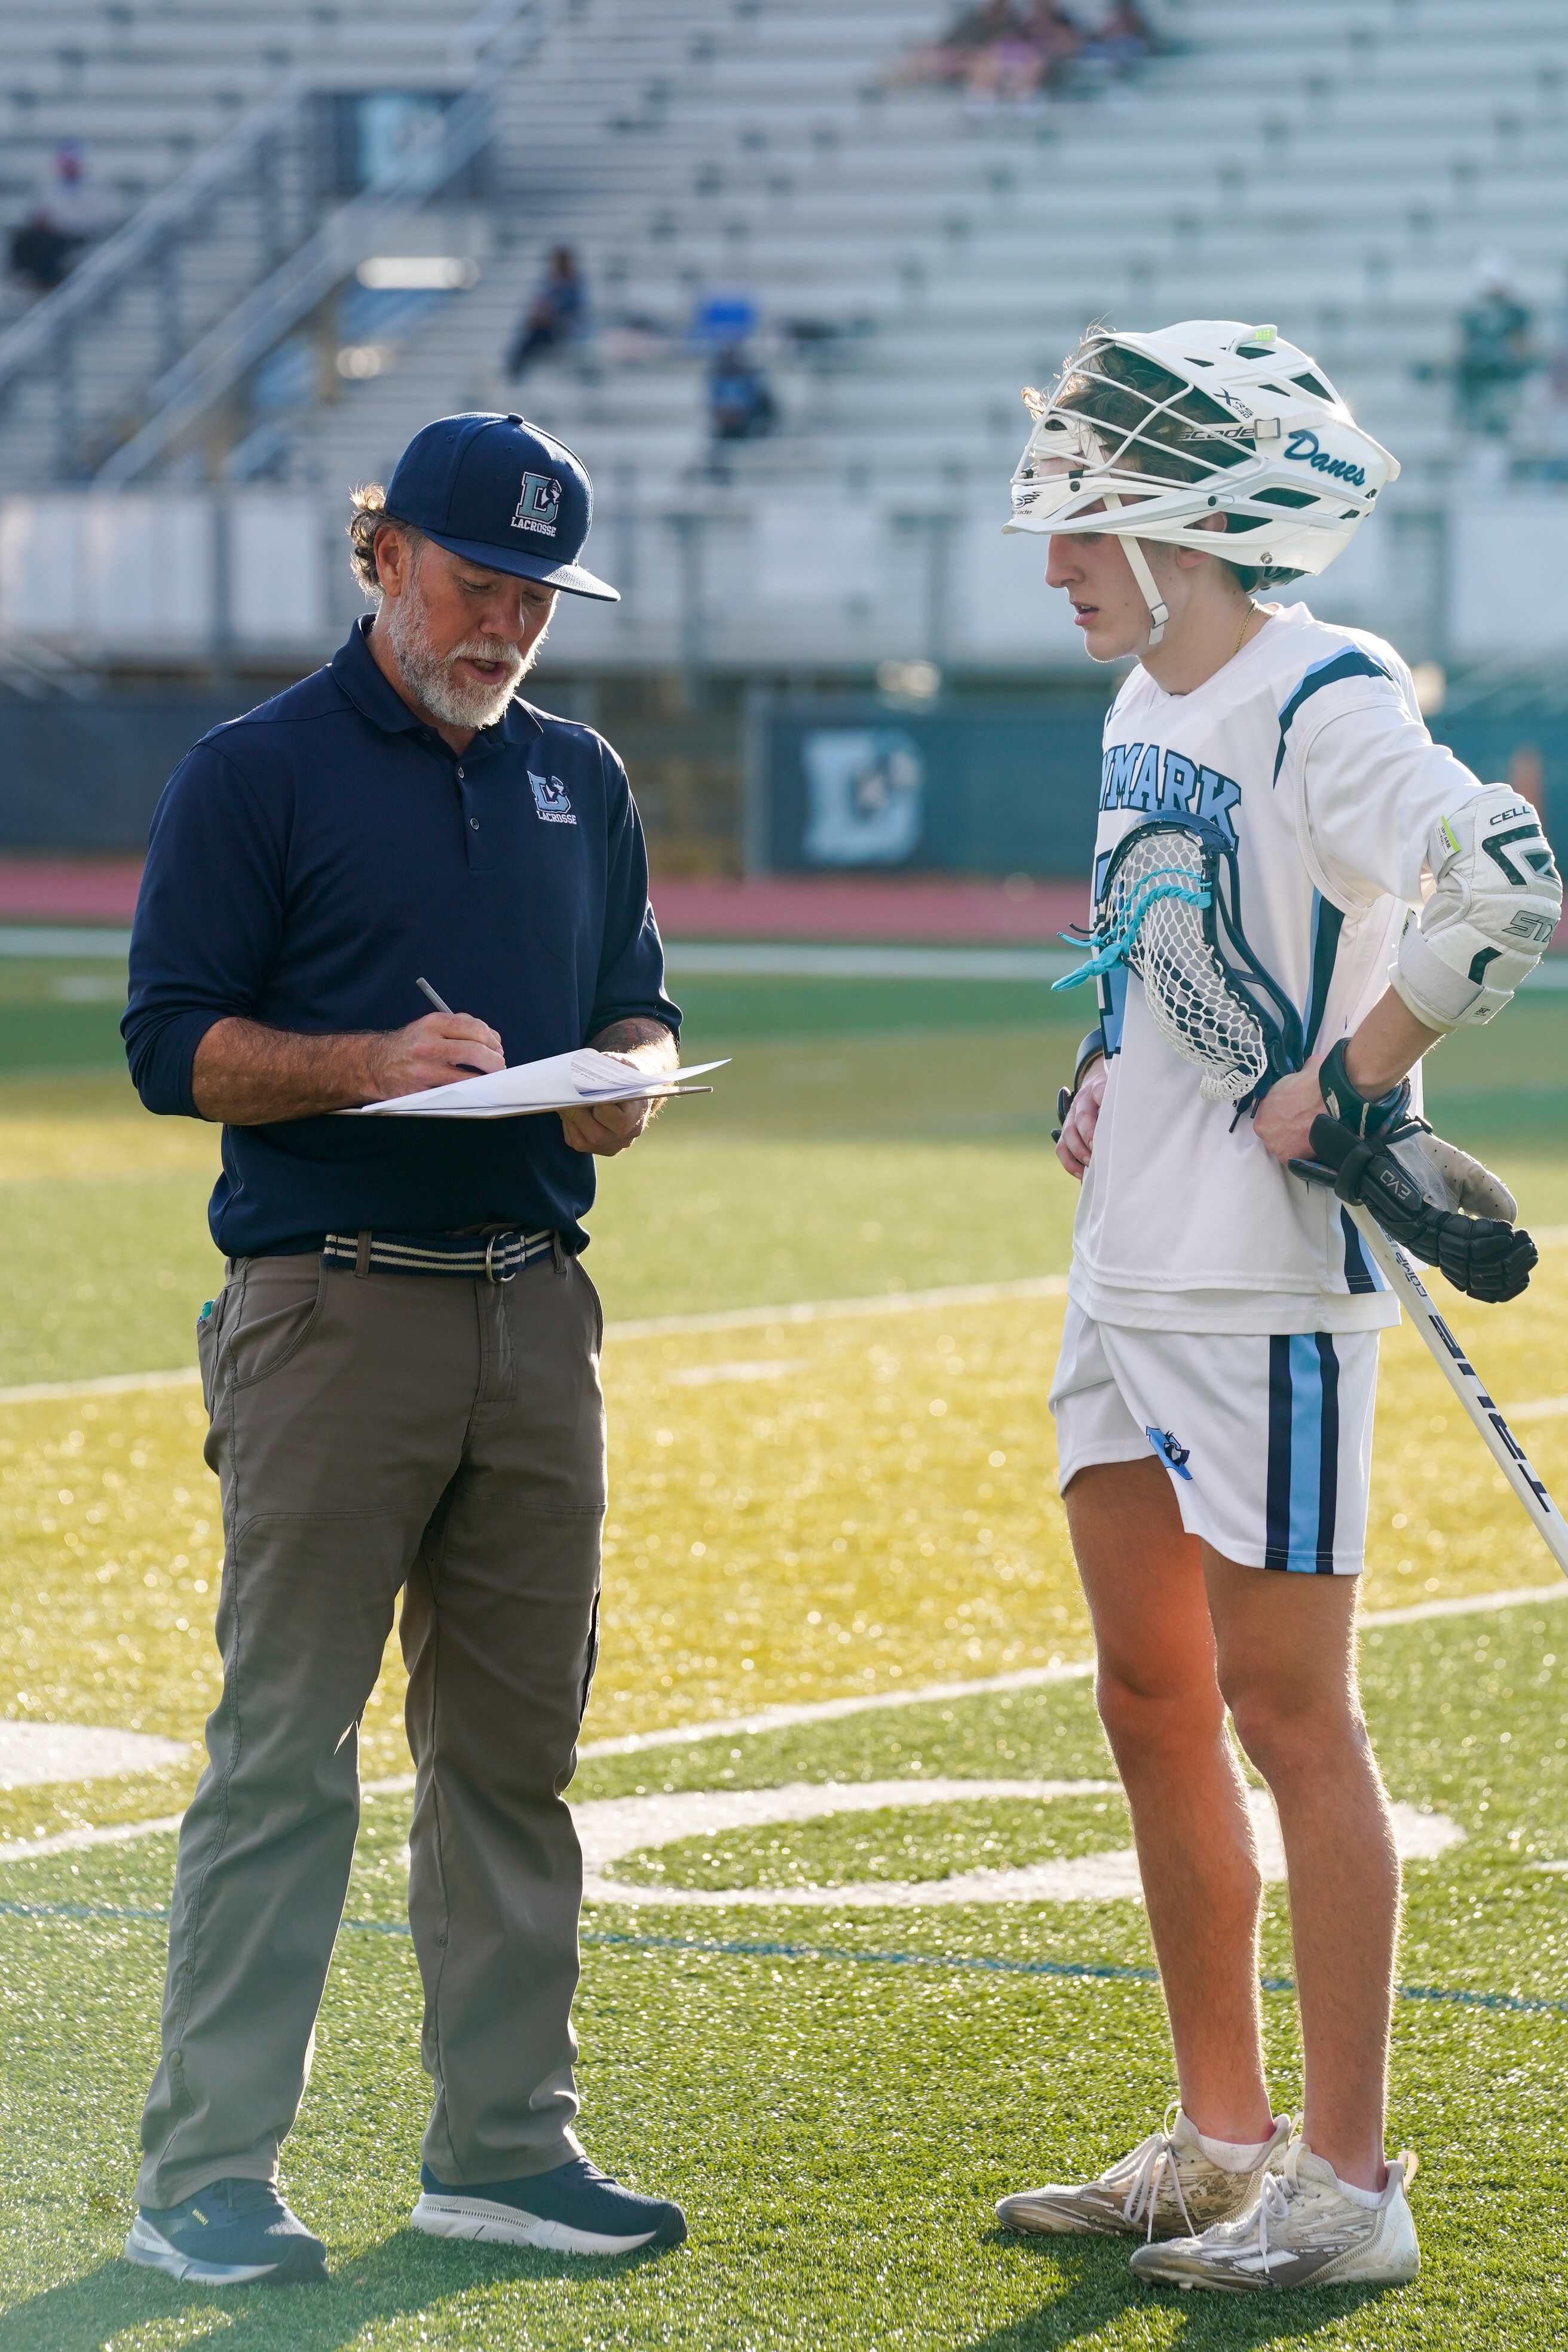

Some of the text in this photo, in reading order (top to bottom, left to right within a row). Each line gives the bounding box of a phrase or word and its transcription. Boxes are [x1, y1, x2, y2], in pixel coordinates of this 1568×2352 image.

[1283, 428, 1365, 486] Danes
[510, 516, 557, 538] LACROSSE
[536, 810, 577, 825] LACROSSE
[1489, 806, 1531, 826] CELL
[1379, 1169, 1413, 1200] EVO
[1395, 1252, 1428, 1297] COMP
[192, 2208, 209, 2226] BROOKS
